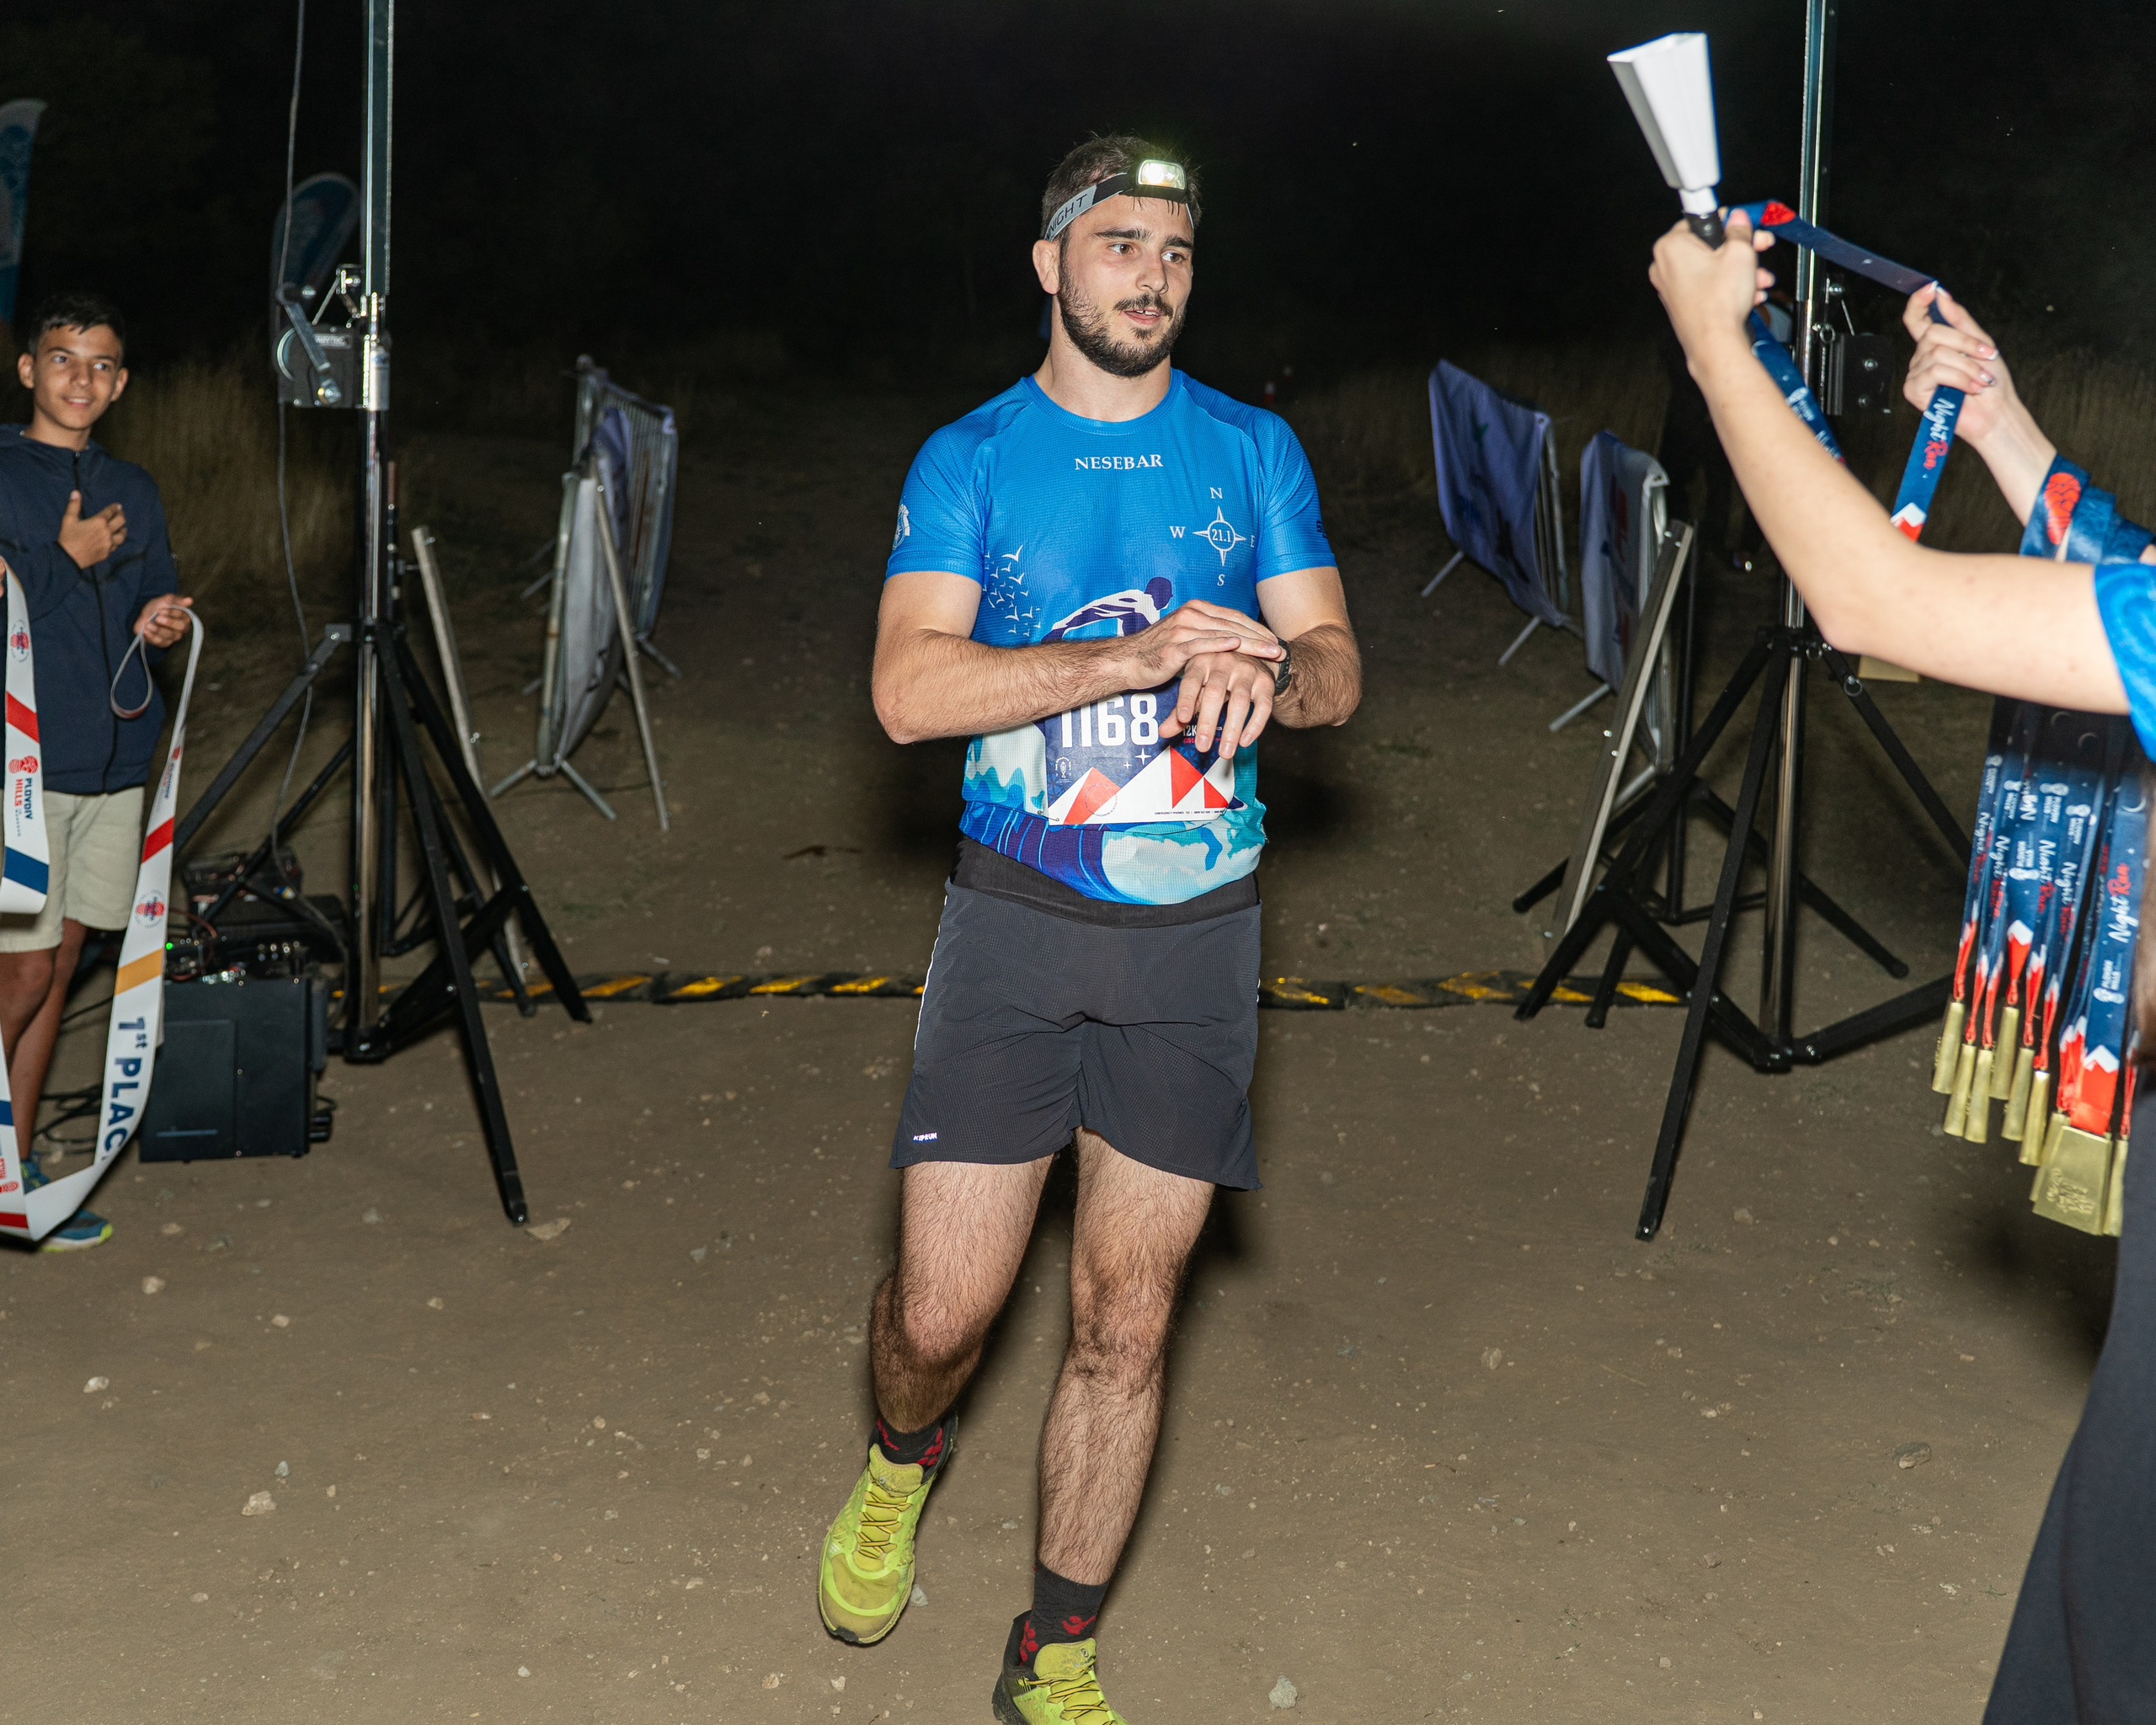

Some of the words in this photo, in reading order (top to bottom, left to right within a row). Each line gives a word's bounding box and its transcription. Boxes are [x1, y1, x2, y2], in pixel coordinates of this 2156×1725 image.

[1923, 398, 1956, 441] Night
[1075, 455, 1163, 470] NESEBAR
[1923, 440, 1948, 470] Run
[1209, 487, 1223, 499] N
[1169, 526, 1186, 538] W
[1211, 529, 1231, 542] 21.1
[1217, 574, 1225, 586] S
[1061, 693, 1159, 748] 1168
[14, 778, 24, 807] HILLS
[24, 777, 33, 820] PLOVDIV
[2107, 862, 2132, 895] Run
[2107, 895, 2139, 943] Night
[117, 1016, 147, 1049] 1st
[102, 1057, 142, 1161] PLAC
[913, 1132, 937, 1141] KIPRUN
